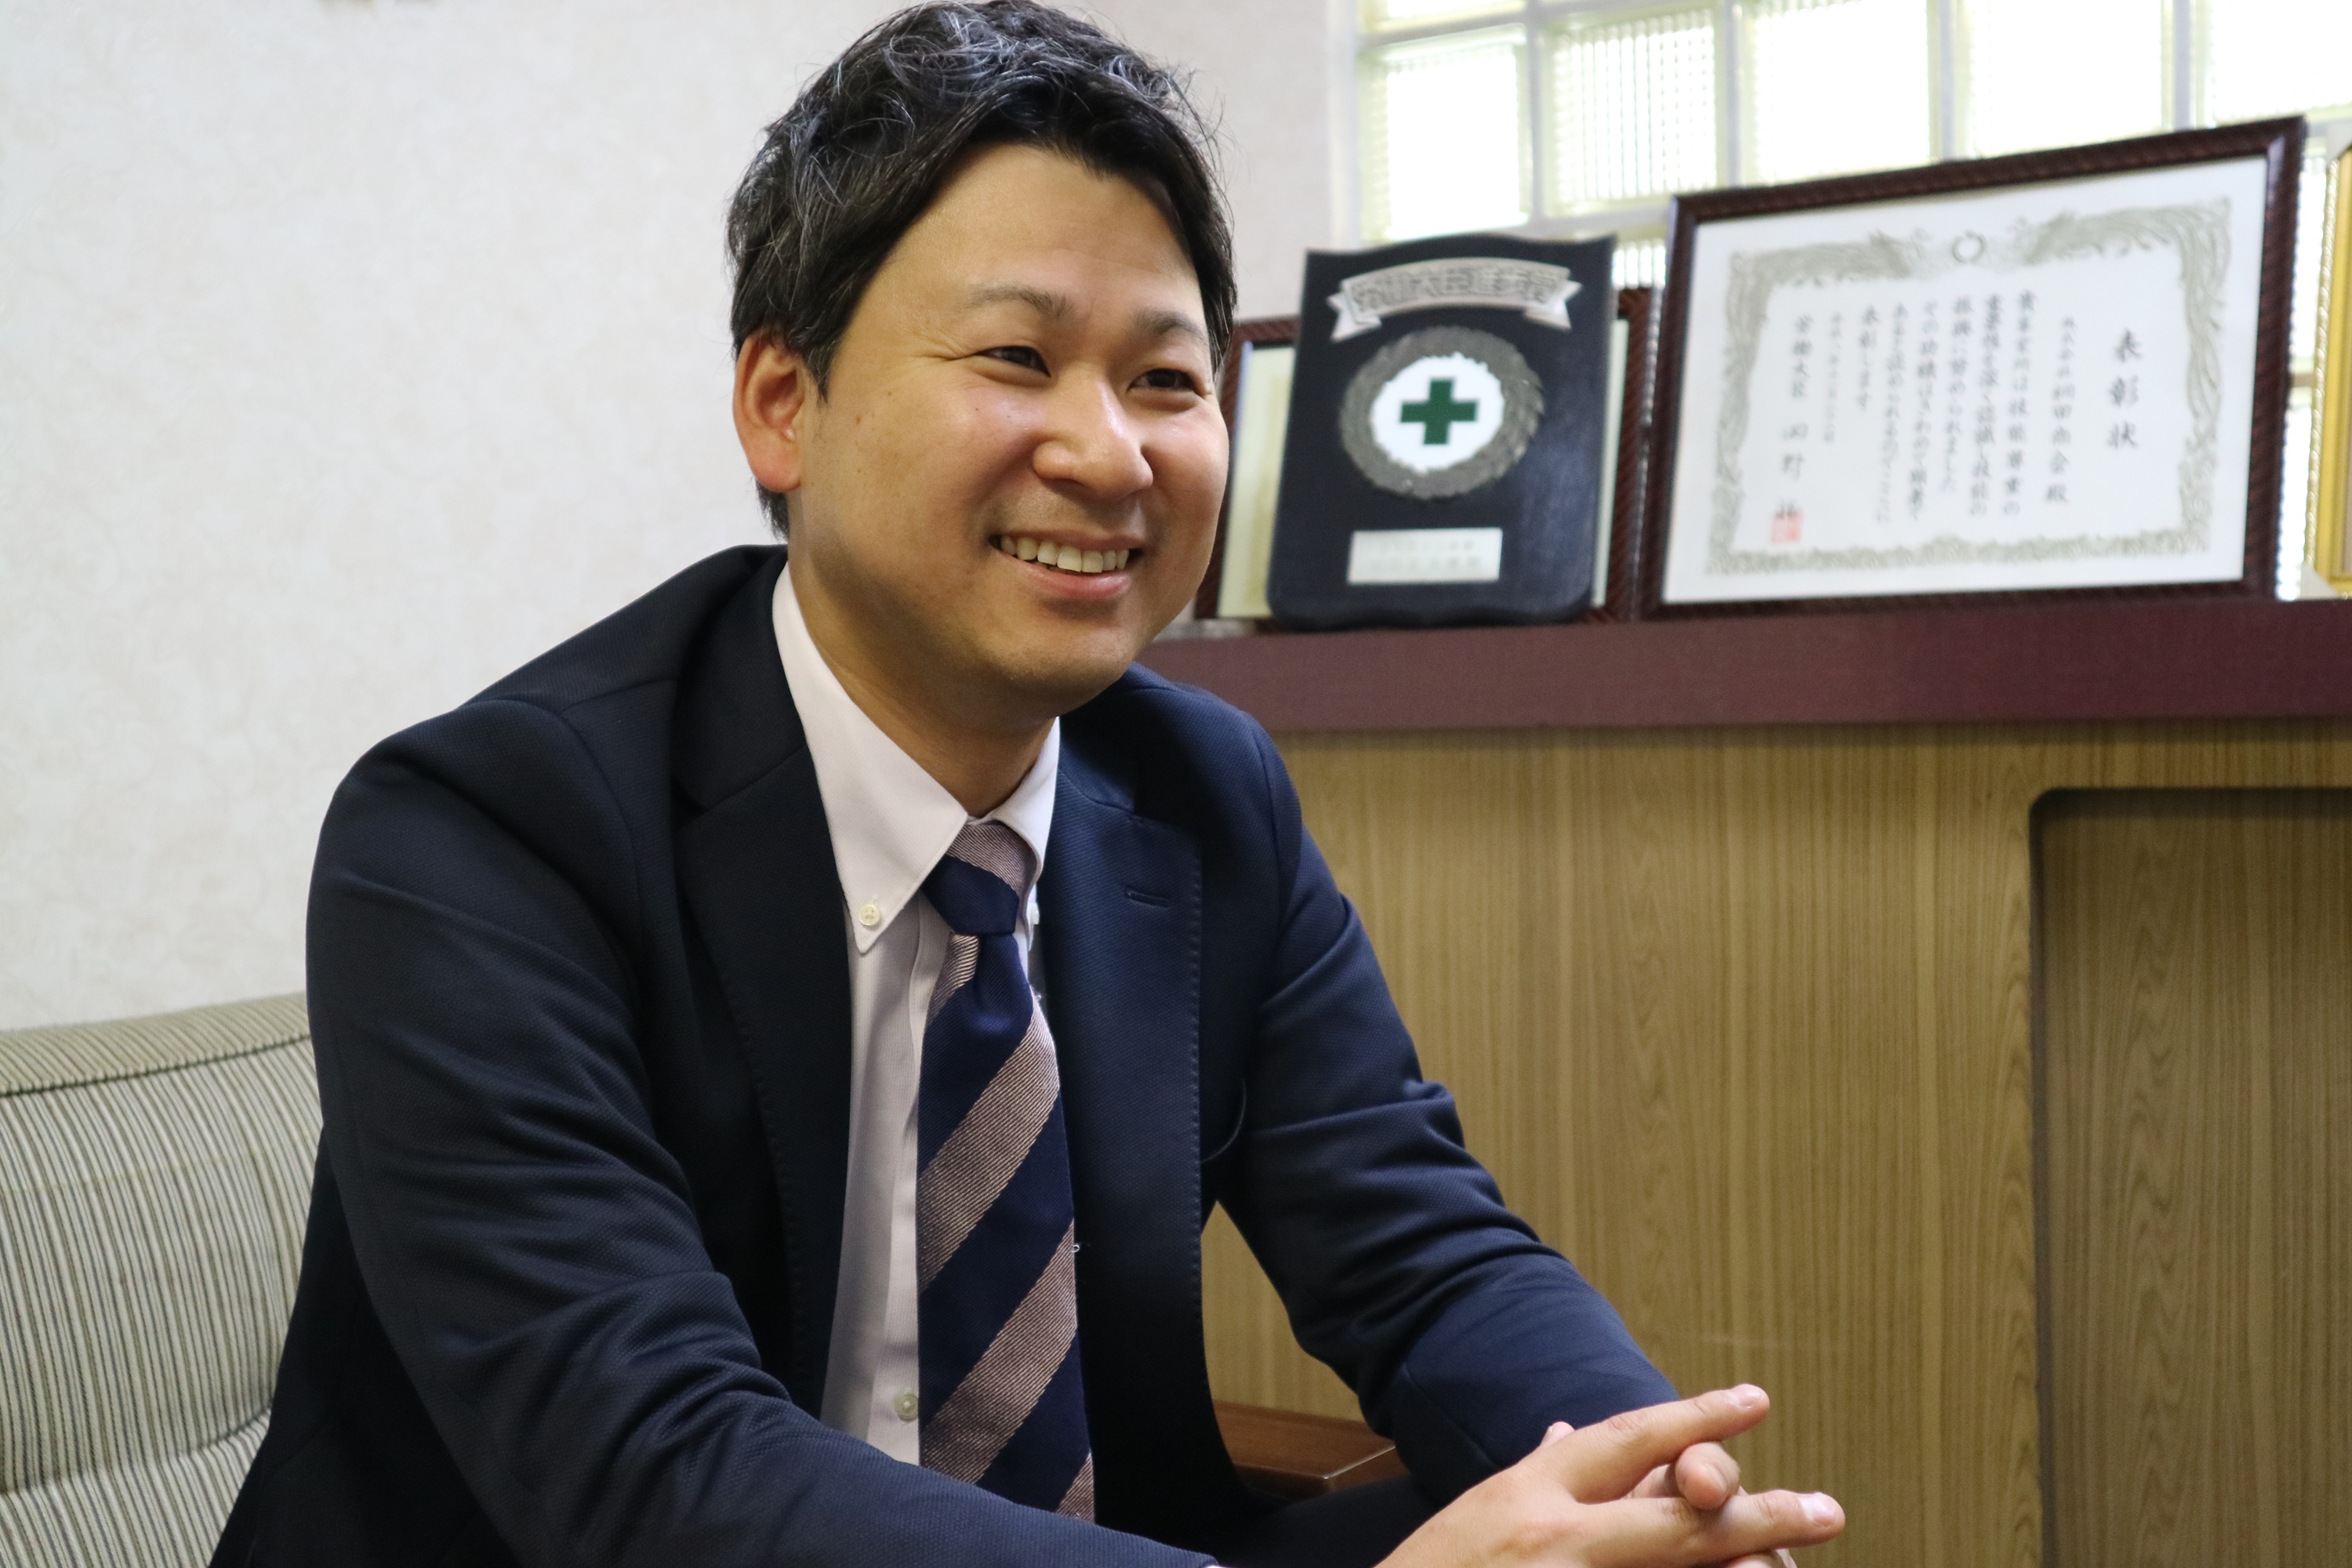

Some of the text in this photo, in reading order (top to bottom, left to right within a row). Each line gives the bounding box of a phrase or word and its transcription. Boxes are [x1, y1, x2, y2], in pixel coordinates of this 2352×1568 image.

[1856, 303, 1881, 412] 表彰します
[2107, 327, 2143, 449] 表彰状
